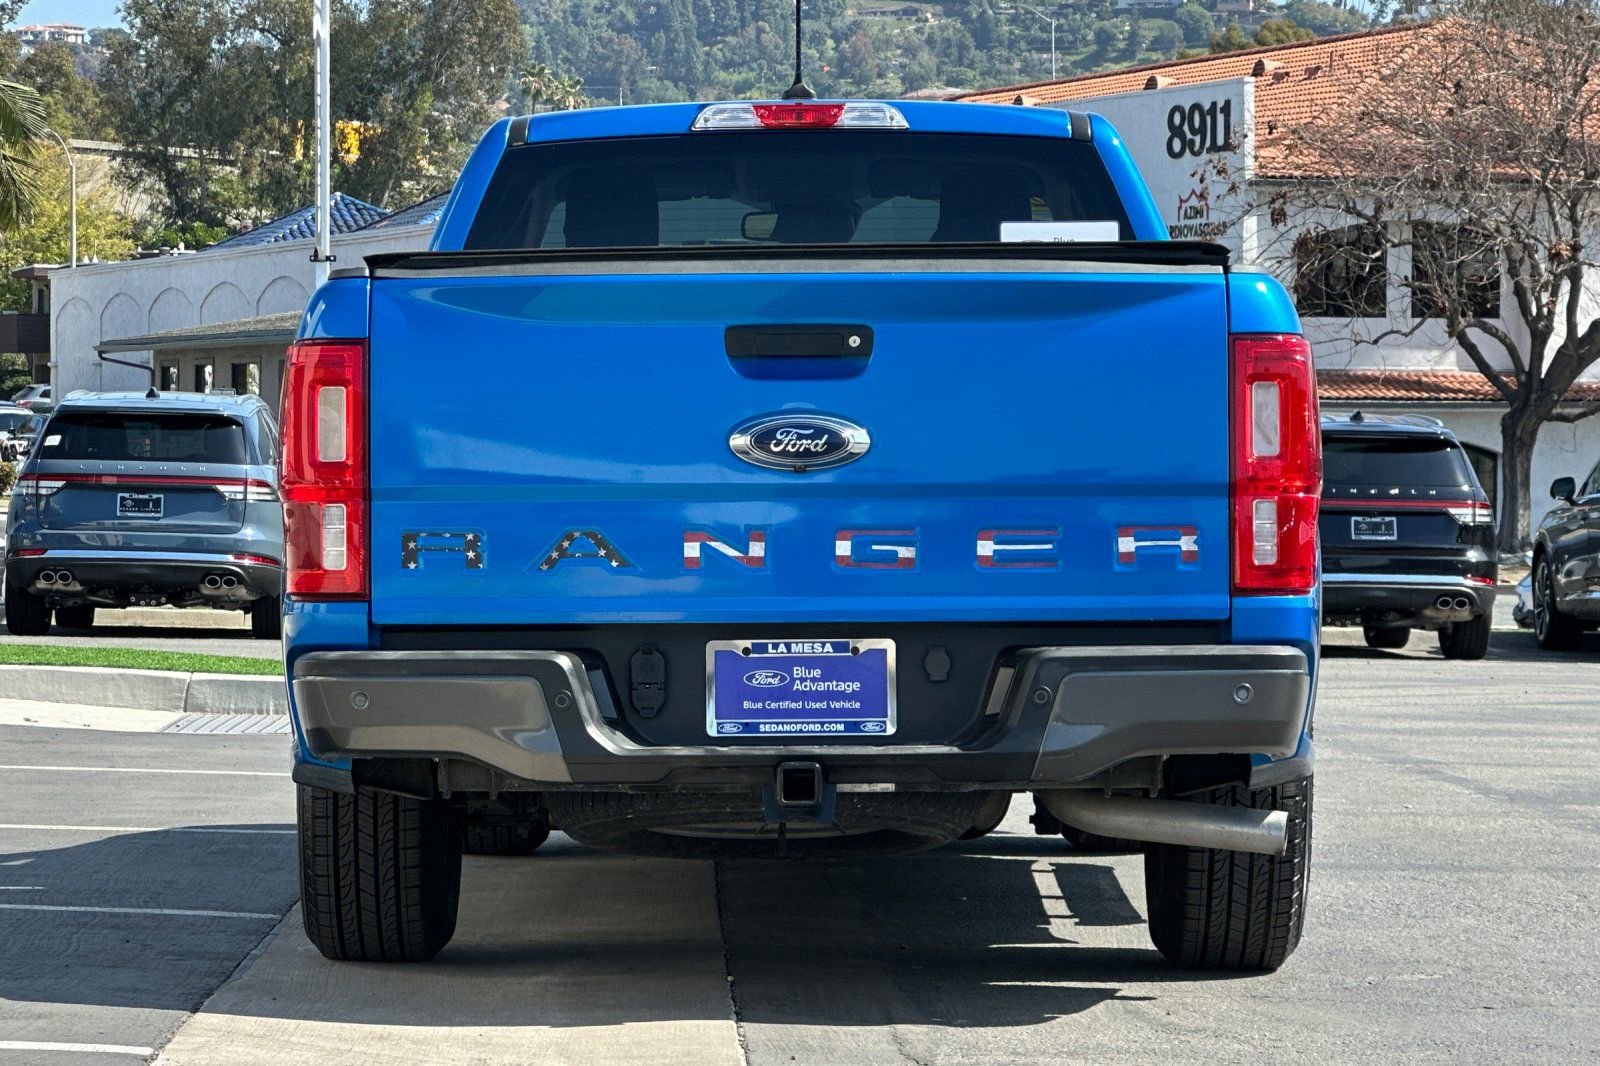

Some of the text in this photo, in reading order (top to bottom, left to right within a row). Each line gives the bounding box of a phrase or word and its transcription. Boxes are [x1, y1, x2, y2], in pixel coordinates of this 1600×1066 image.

[1166, 99, 1232, 159] 8911
[770, 428, 828, 452] Ford
[401, 525, 1199, 571] RANGER
[768, 642, 834, 654] LA MESA
[752, 672, 780, 685] Ford
[793, 666, 822, 678] Blue
[793, 680, 861, 693] Advantage
[743, 700, 861, 709] Blue Certified Used Vehicle
[759, 723, 845, 732] SEDANOFORD.COM
